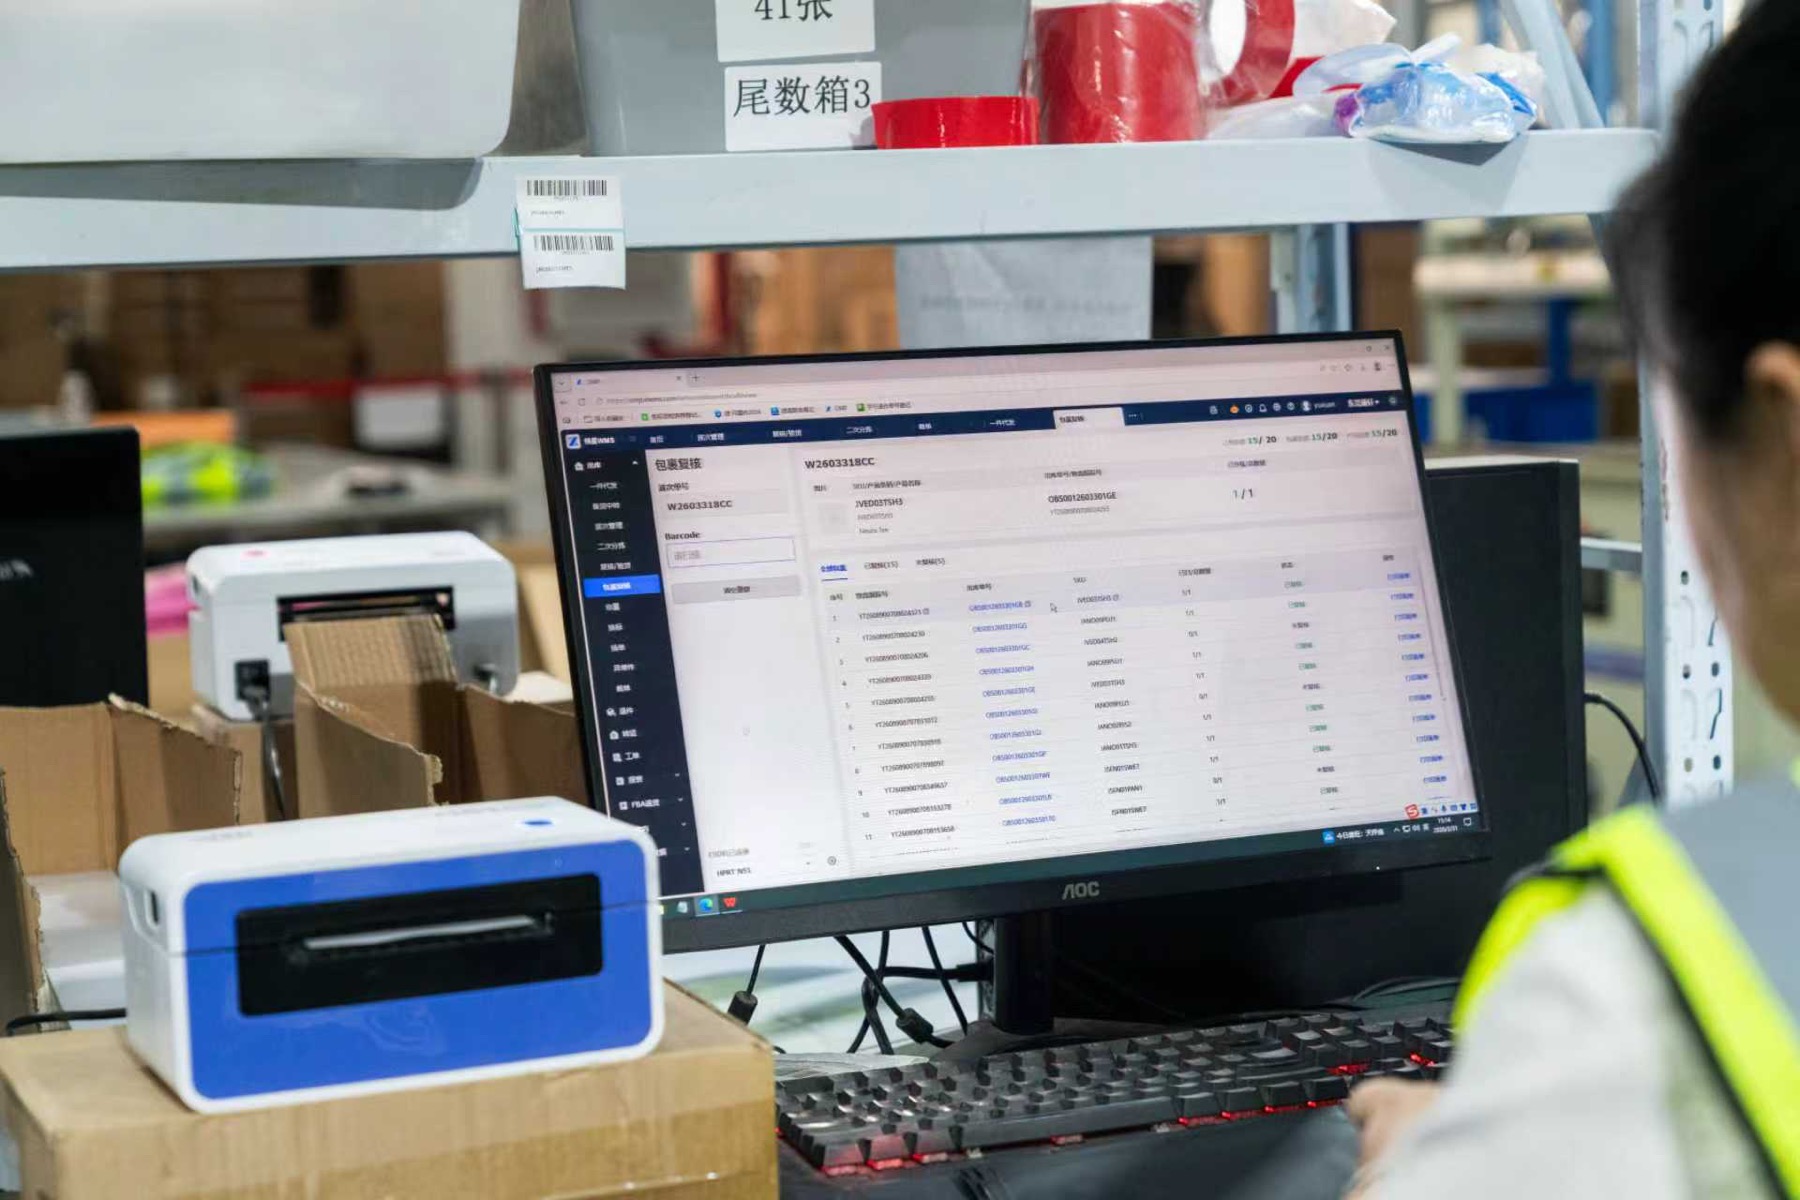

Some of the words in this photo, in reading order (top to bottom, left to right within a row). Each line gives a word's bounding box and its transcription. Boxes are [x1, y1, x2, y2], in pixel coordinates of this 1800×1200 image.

[733, 75, 871, 117] 尾数箱3
[805, 457, 875, 469] W2603318CC
[667, 499, 733, 511] W2603318CC
[664, 531, 701, 541] Barcode
[1062, 881, 1100, 900] AOC
